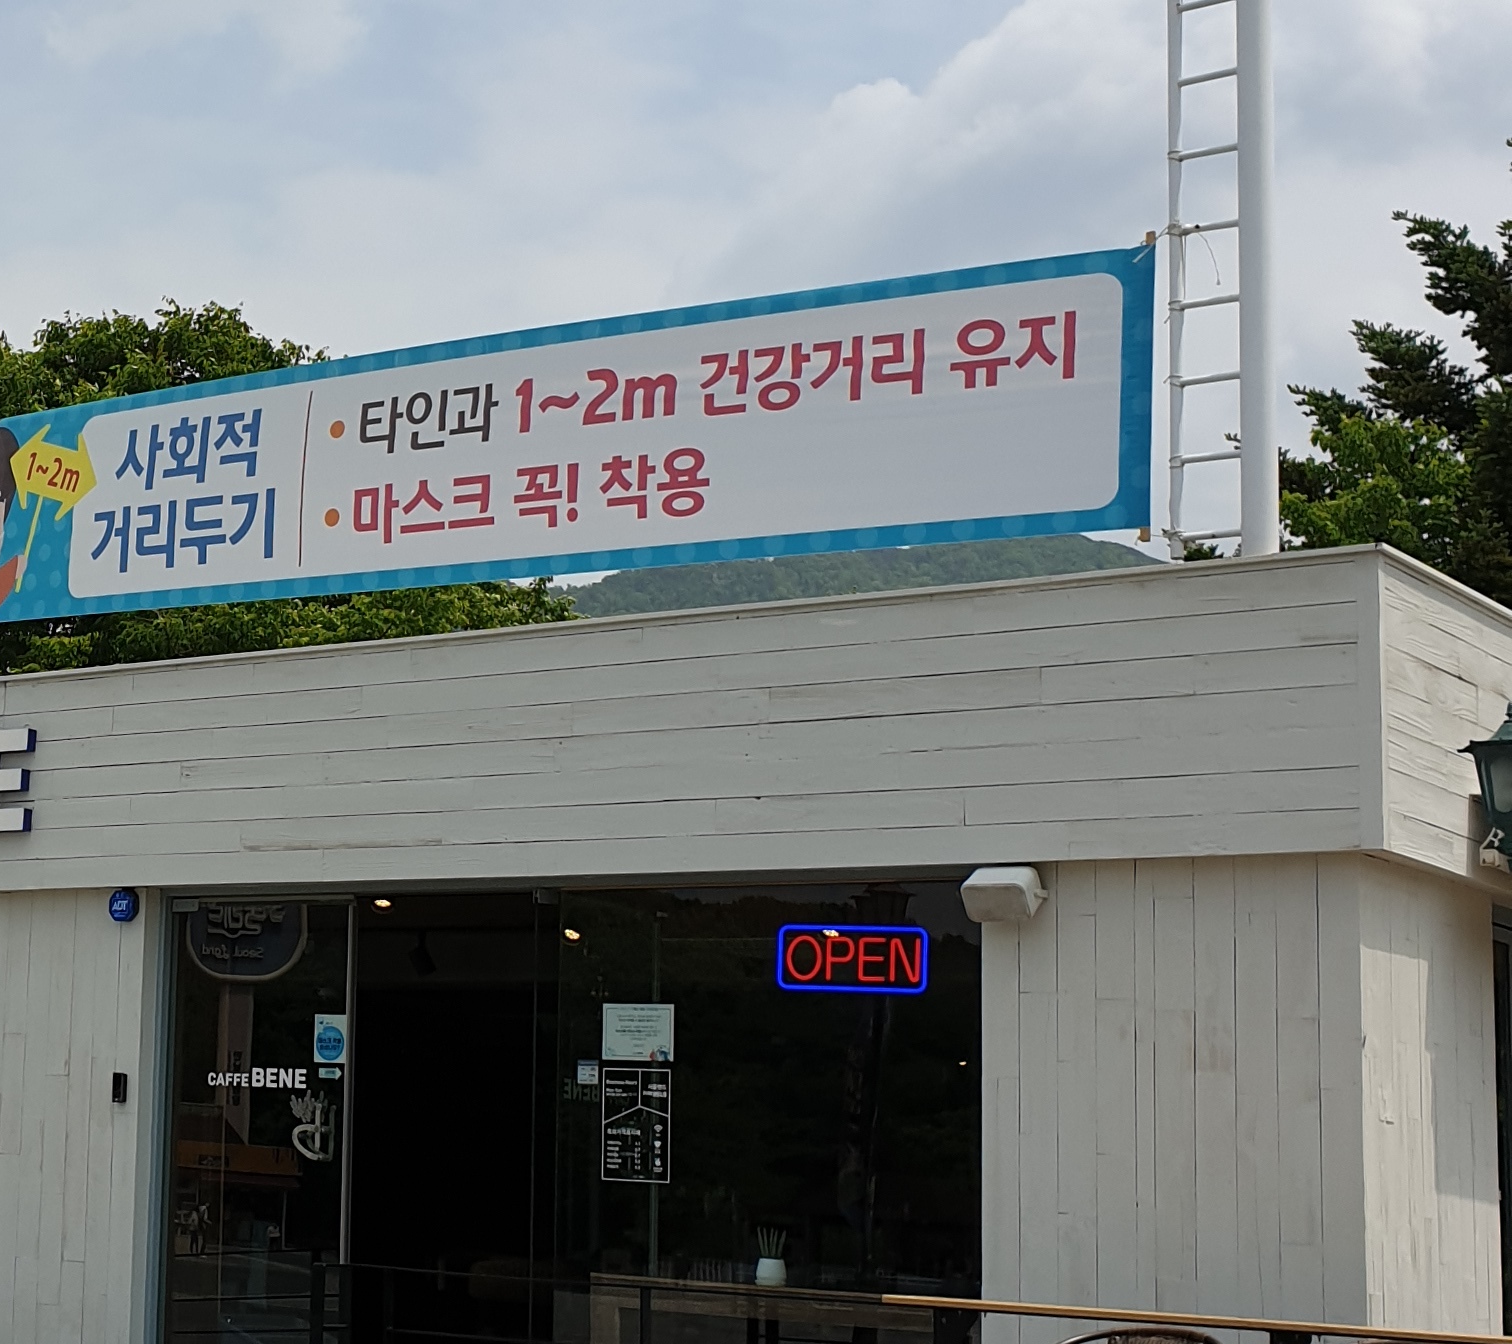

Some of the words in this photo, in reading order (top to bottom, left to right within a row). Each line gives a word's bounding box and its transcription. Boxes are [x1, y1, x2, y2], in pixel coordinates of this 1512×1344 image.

[359, 383, 499, 453] 타인과
[514, 368, 678, 433] 1~2m
[699, 328, 926, 416] 건강거리
[949, 310, 1077, 389] 유지
[26, 452, 80, 493] 1~2m
[115, 408, 263, 490] 사회적
[353, 474, 495, 544] 마스크
[513, 462, 580, 528] 꼭!
[599, 447, 710, 519] 착용
[91, 488, 276, 573] 거리두기
[111, 900, 128, 911] ADT
[786, 935, 922, 983] OPEN
[207, 1071, 250, 1087] CAFFE
[251, 1067, 307, 1089] BENE
